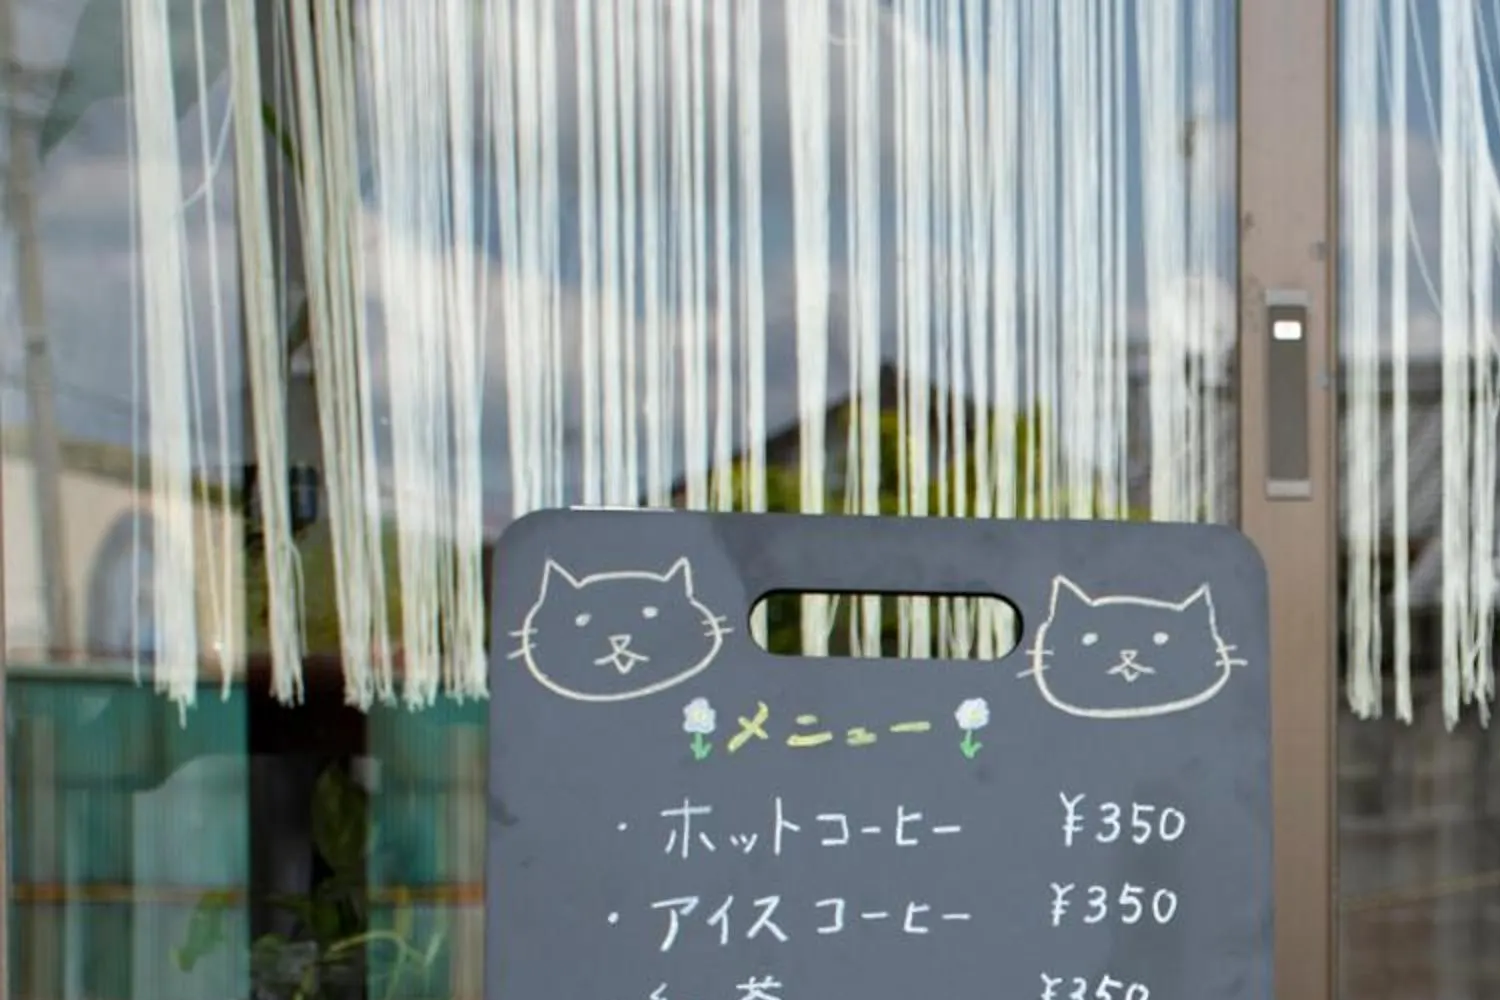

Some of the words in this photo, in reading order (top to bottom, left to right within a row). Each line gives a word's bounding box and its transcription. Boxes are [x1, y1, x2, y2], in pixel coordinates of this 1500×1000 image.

[727, 701, 931, 753] メニュー
[660, 796, 962, 859] ホットコーヒー
[1059, 791, 1186, 847] ¥350
[651, 895, 971, 952] アイスコーヒー
[1050, 882, 1178, 927] ¥350
